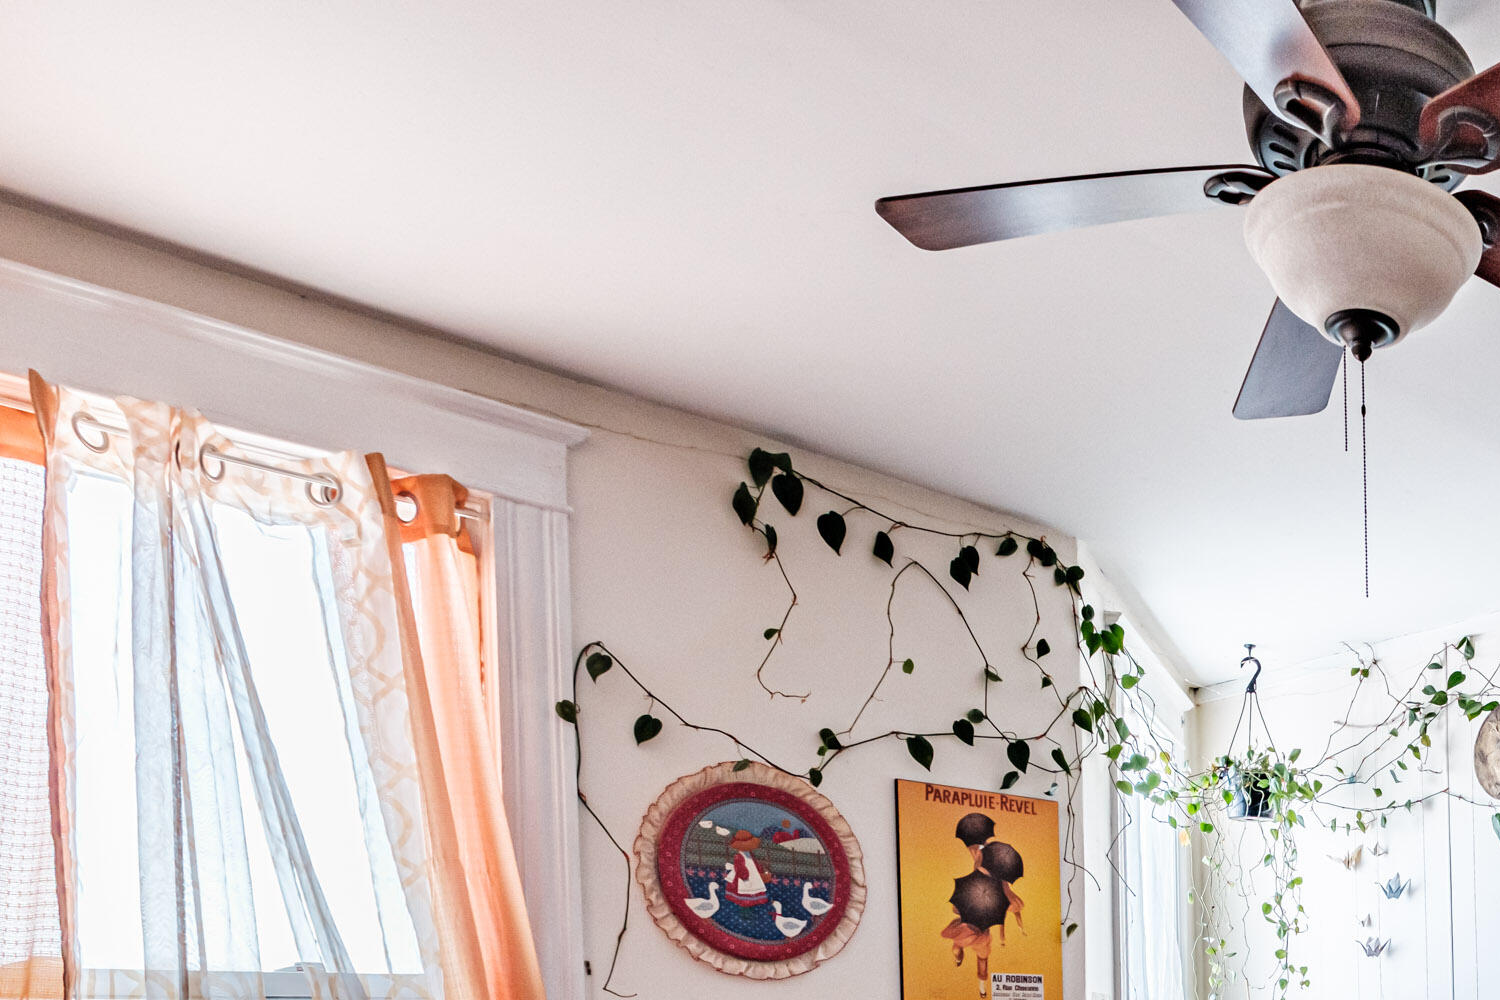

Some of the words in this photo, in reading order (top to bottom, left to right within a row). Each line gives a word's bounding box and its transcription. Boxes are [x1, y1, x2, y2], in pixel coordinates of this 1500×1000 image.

[925, 784, 1037, 815] PARAPLUIE-REVEL
[992, 975, 1003, 983] AU
[1005, 975, 1043, 984] ROBINSON
